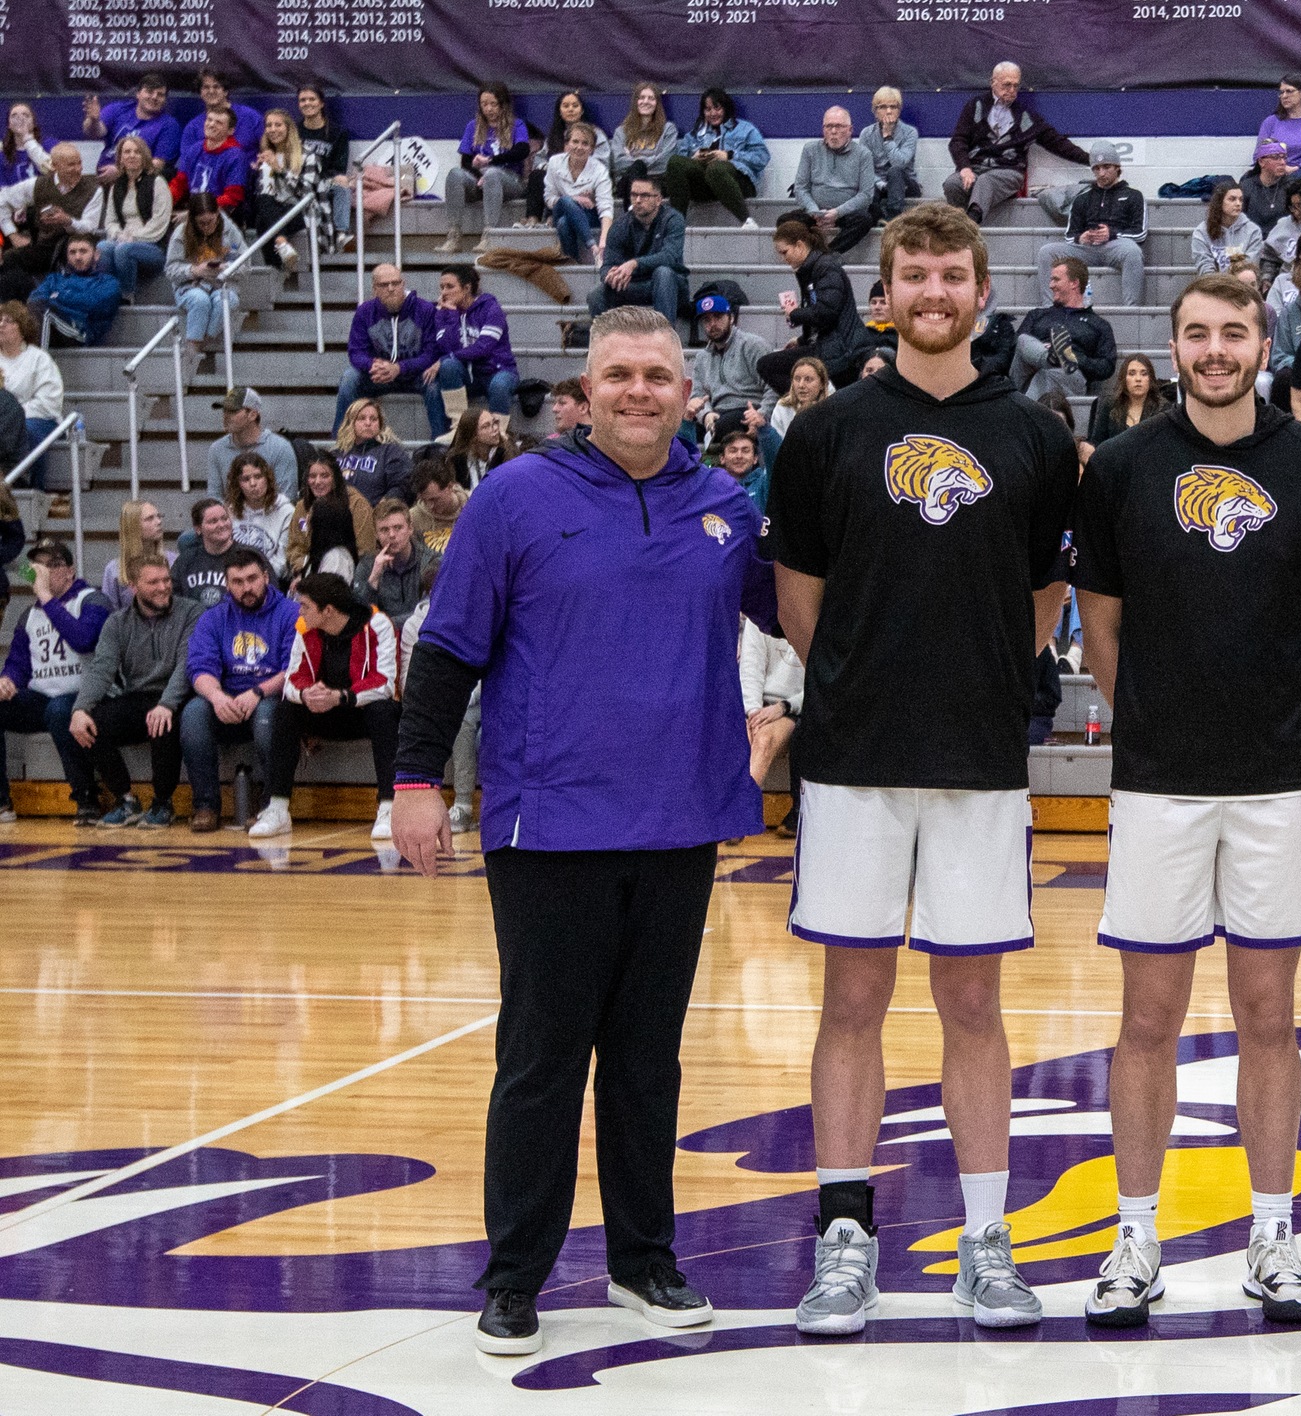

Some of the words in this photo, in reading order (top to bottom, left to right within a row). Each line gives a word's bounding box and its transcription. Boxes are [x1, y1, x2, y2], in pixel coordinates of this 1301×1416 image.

[68, 0, 102, 12] 2002,
[104, 0, 139, 12] 2003,
[141, 0, 177, 12] 2006,
[180, 0, 214, 12] 2007,
[1133, 5, 1170, 20] 2014,
[1172, 5, 1206, 20] 2017,
[1208, 5, 1241, 18] 2020
[68, 14, 103, 28] 2008,
[106, 14, 140, 28] 2009,
[143, 14, 177, 28] 2010,
[180, 14, 214, 28] 2011,
[277, 12, 312, 27] 2007,
[314, 12, 349, 27] 2011,
[352, 12, 386, 27] 2012,
[390, 12, 425, 27] 2013,
[687, 10, 723, 24] 2019,
[726, 10, 756, 23] 2021
[896, 8, 932, 22] 2016,
[936, 8, 969, 22] 2017,
[972, 8, 1004, 21] 2018
[72, 30, 106, 46] 2012,
[109, 30, 144, 46] 2013,
[146, 30, 180, 46] 2014,
[183, 30, 218, 46] 2015,
[278, 29, 312, 44] 2014,
[315, 29, 350, 44] 2015,
[352, 29, 387, 44] 2016,
[390, 29, 425, 44] 2019,
[69, 48, 102, 63] 2016,
[105, 48, 138, 63] 2017,
[140, 48, 173, 63] 2018,
[176, 48, 210, 63] 2019,
[278, 47, 308, 60] 2020
[69, 65, 100, 78] 2020
[187, 570, 227, 589] OLIV
[39, 637, 67, 663] 34
